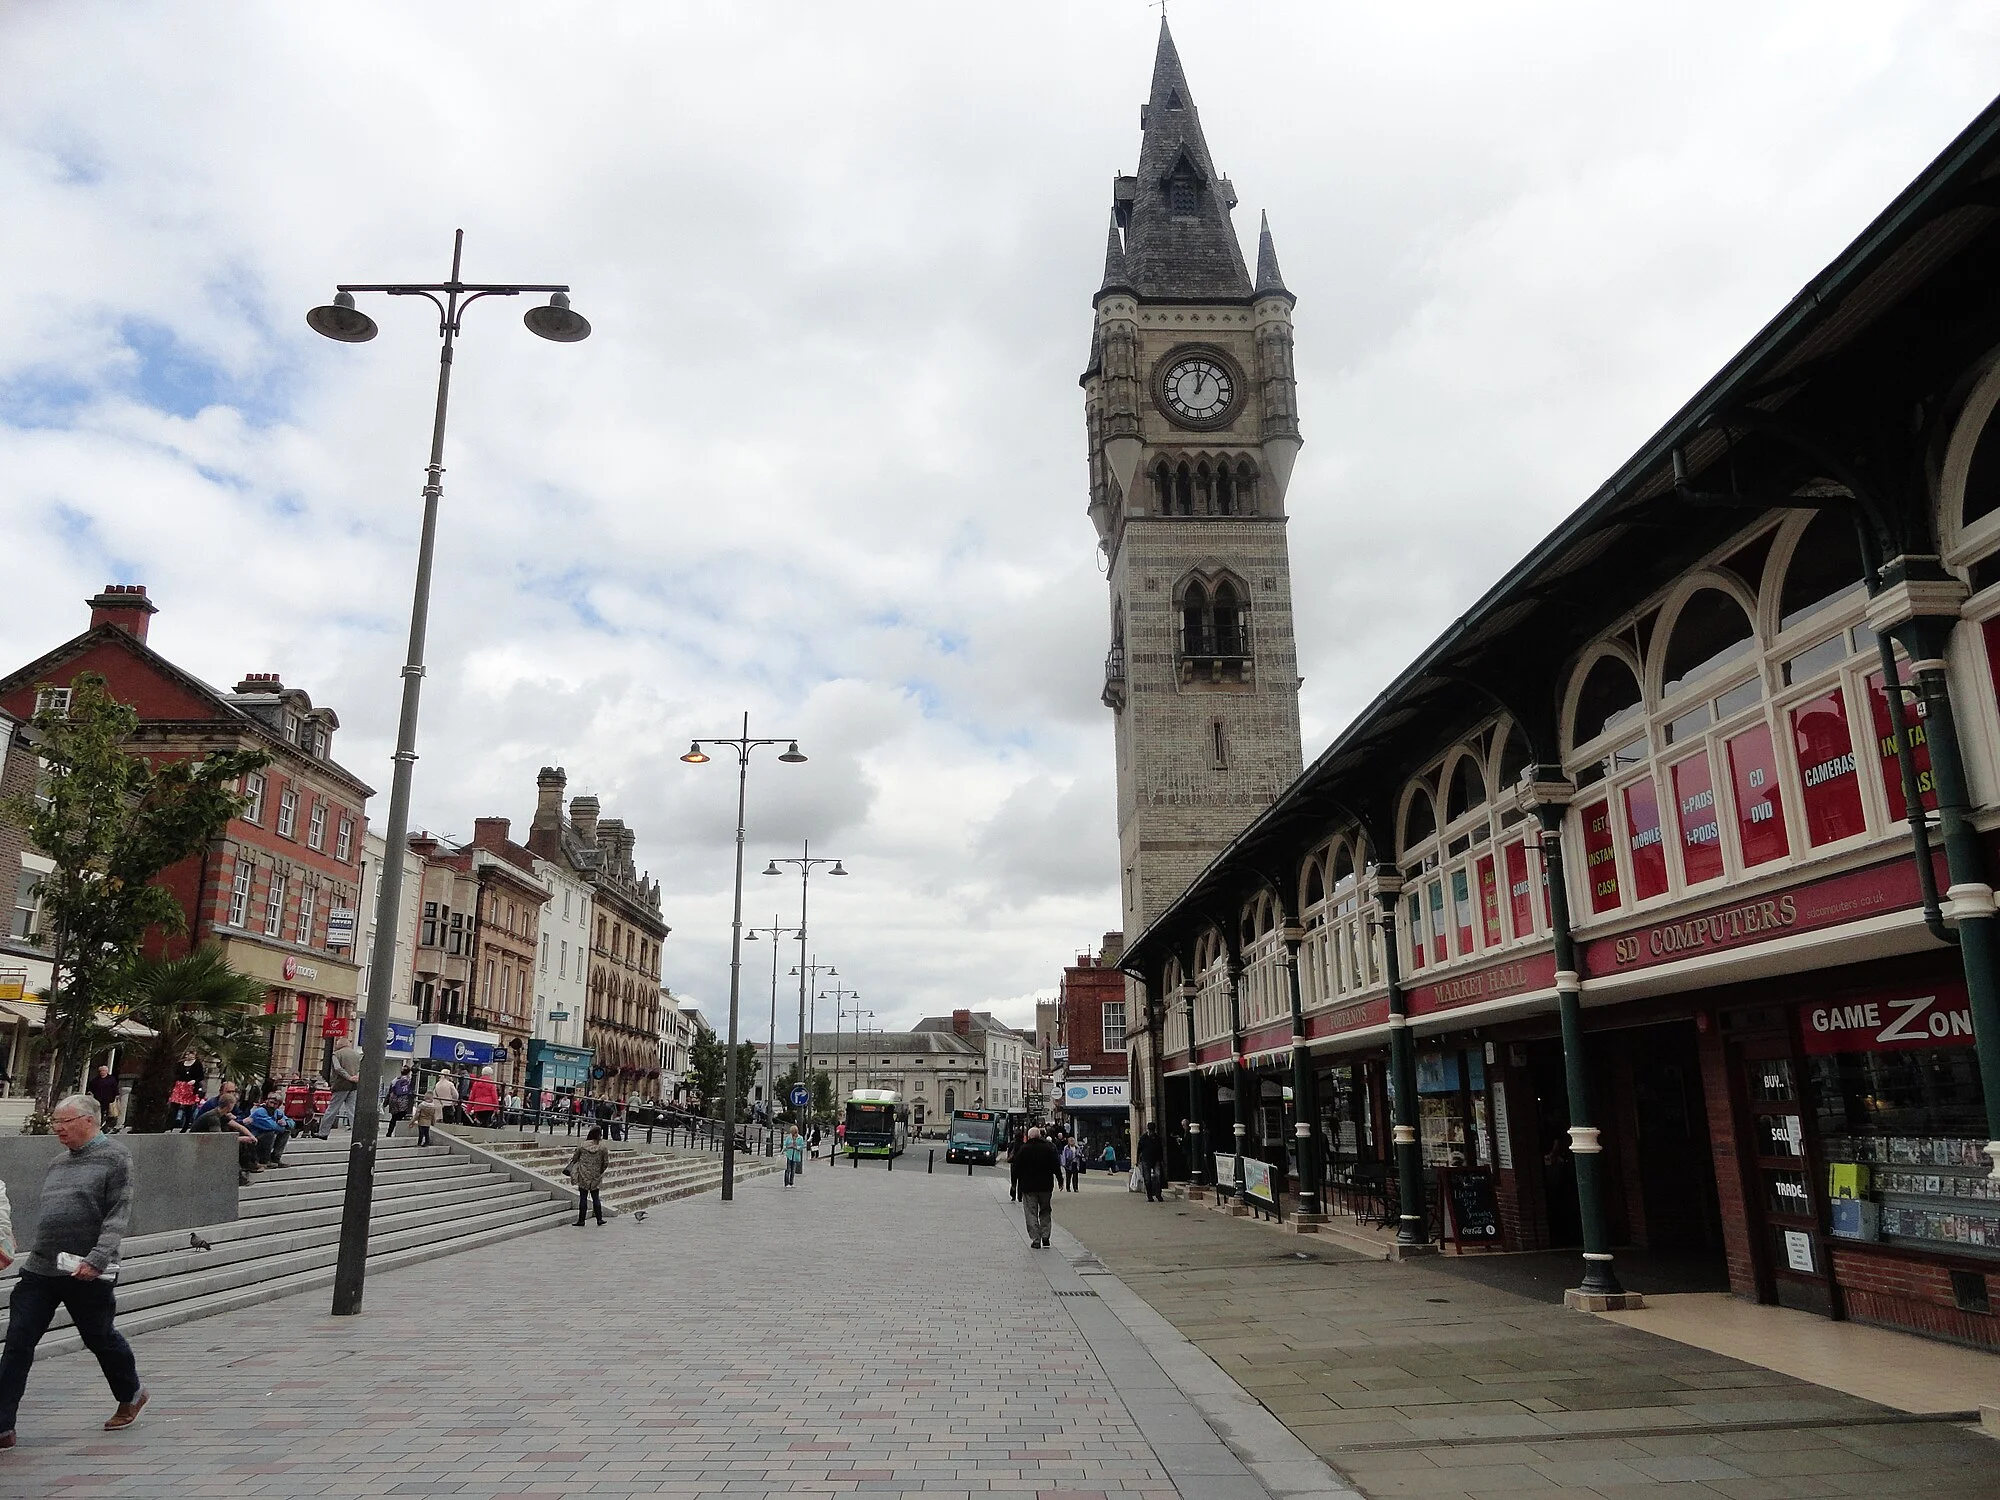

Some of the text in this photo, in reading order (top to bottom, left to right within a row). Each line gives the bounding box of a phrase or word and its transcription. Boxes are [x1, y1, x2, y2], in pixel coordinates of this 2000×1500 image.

[1918, 703, 1925, 714] 4
[1881, 725, 1927, 757] INTA
[1750, 768, 1764, 788] CD
[1804, 752, 1856, 787] CAMERAS
[1682, 790, 1713, 815] i-PADS
[1751, 801, 1773, 823] DVD
[1592, 816, 1605, 832] GET
[1687, 822, 1718, 846] i-PODS
[1631, 827, 1662, 851] MOBILE
[1588, 846, 1615, 867] INSTAN
[1513, 880, 1530, 897] GAME
[1597, 879, 1617, 897] CASH
[1615, 895, 1798, 963] SD COMPUTERS
[297, 965, 318, 980] money
[1434, 965, 1527, 1004] MARKET HALL
[1812, 996, 1973, 1042] GAME ZON
[1092, 1086, 1122, 1095] EDEN
